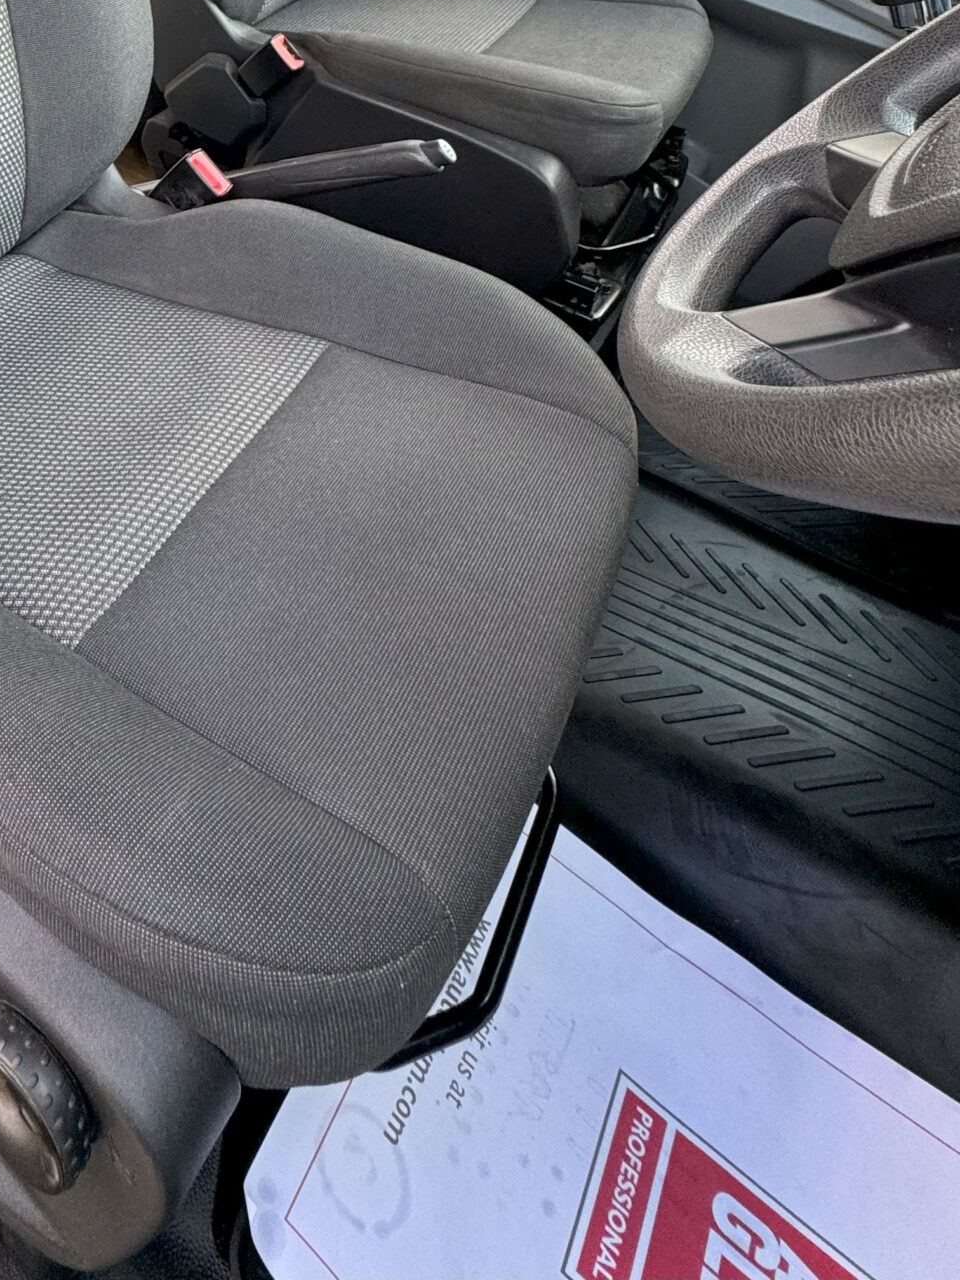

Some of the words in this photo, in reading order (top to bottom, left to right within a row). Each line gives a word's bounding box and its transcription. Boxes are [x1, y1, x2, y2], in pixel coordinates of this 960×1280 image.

[457, 1050, 478, 1081] us
[446, 1080, 465, 1109] at
[592, 1105, 653, 1280] PROFESSIONAL
